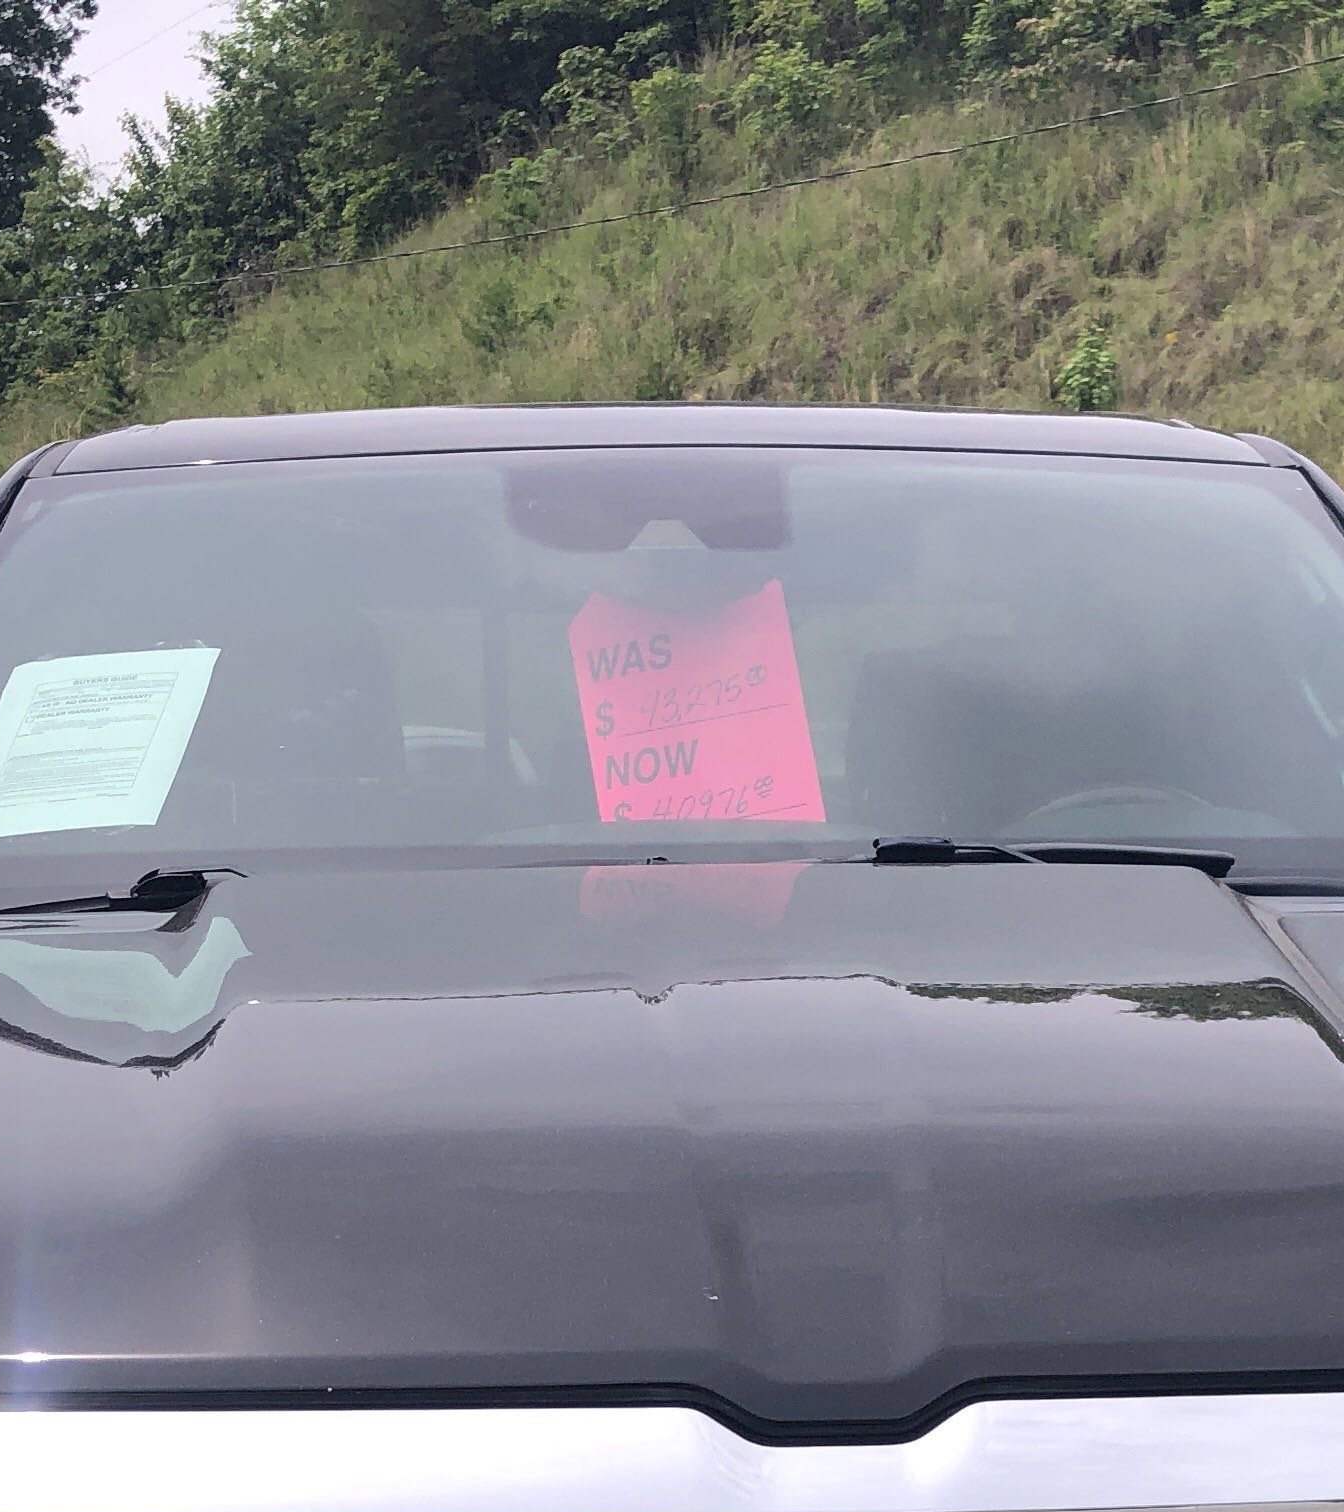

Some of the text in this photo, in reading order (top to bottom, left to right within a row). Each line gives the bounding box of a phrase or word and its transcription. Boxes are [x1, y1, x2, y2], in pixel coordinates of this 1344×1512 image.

[586, 633, 673, 683] WAS
[594, 697, 616, 741] $
[605, 739, 699, 789] NOW
